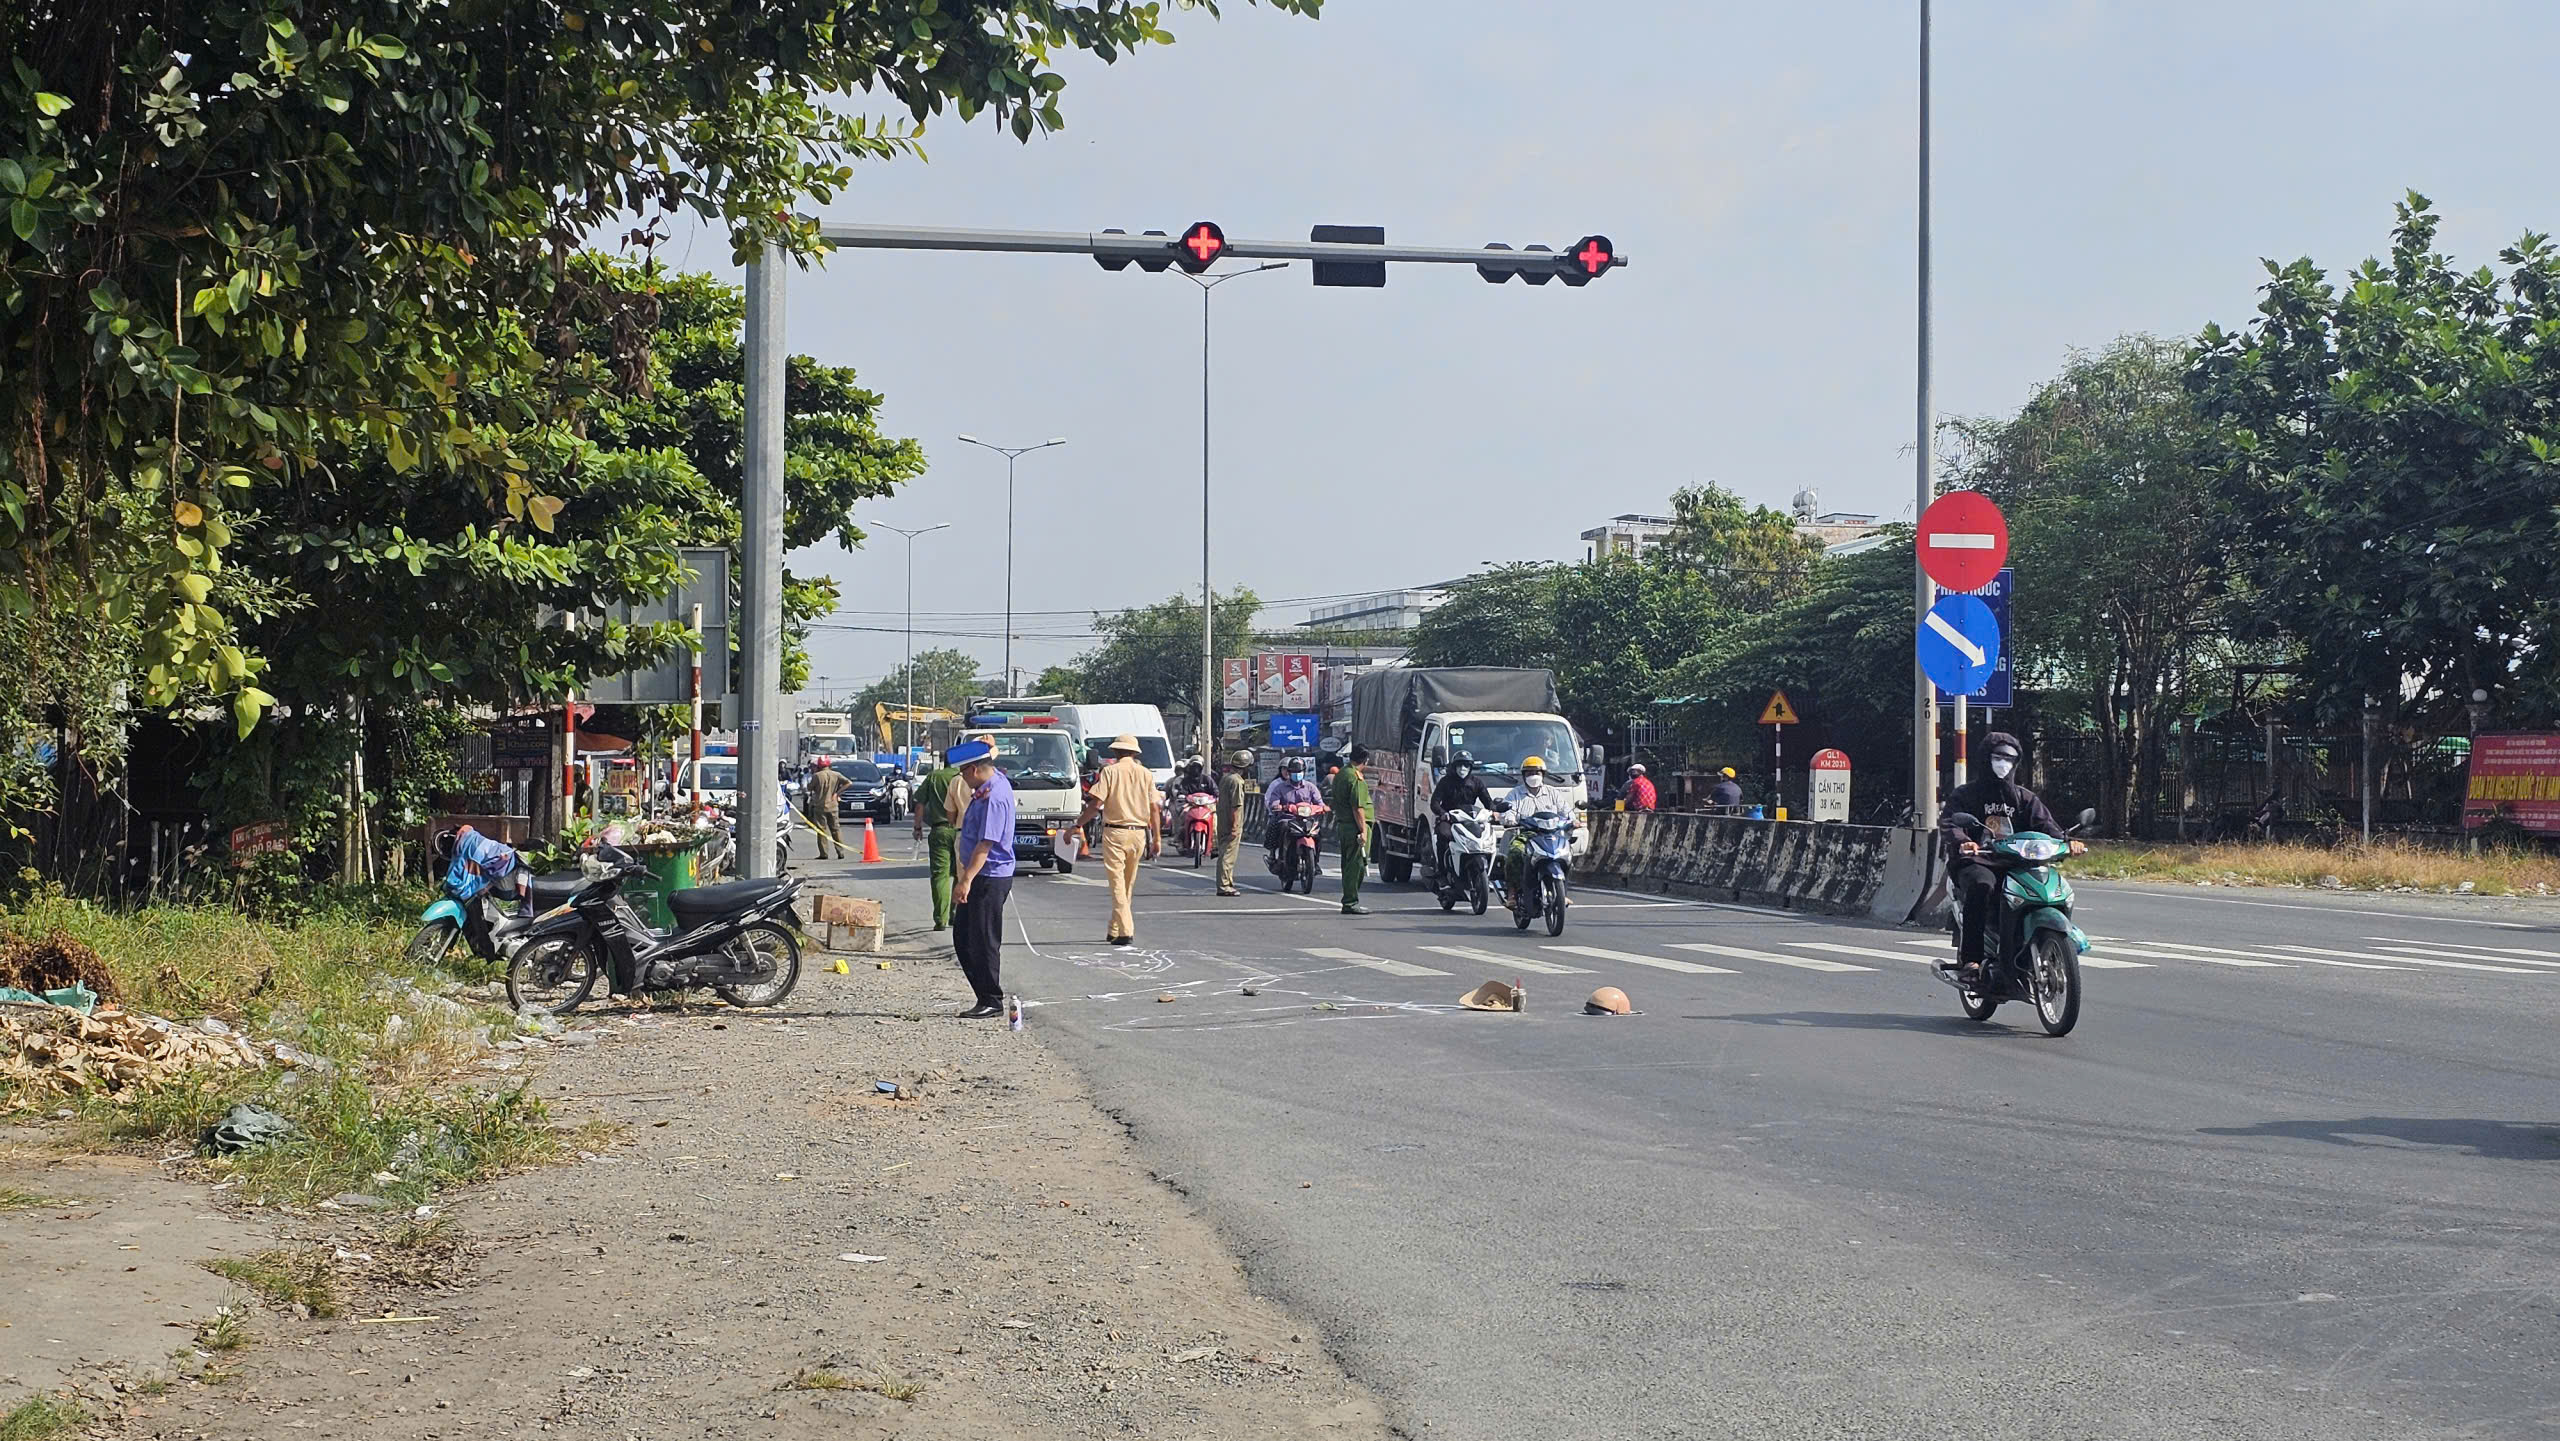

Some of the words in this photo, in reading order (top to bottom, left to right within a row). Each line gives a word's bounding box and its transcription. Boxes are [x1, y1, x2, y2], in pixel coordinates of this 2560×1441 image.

[1820, 760, 1831, 768] KM
[1829, 798, 1842, 810] Km
[597, 919, 616, 927] YAMAHA
